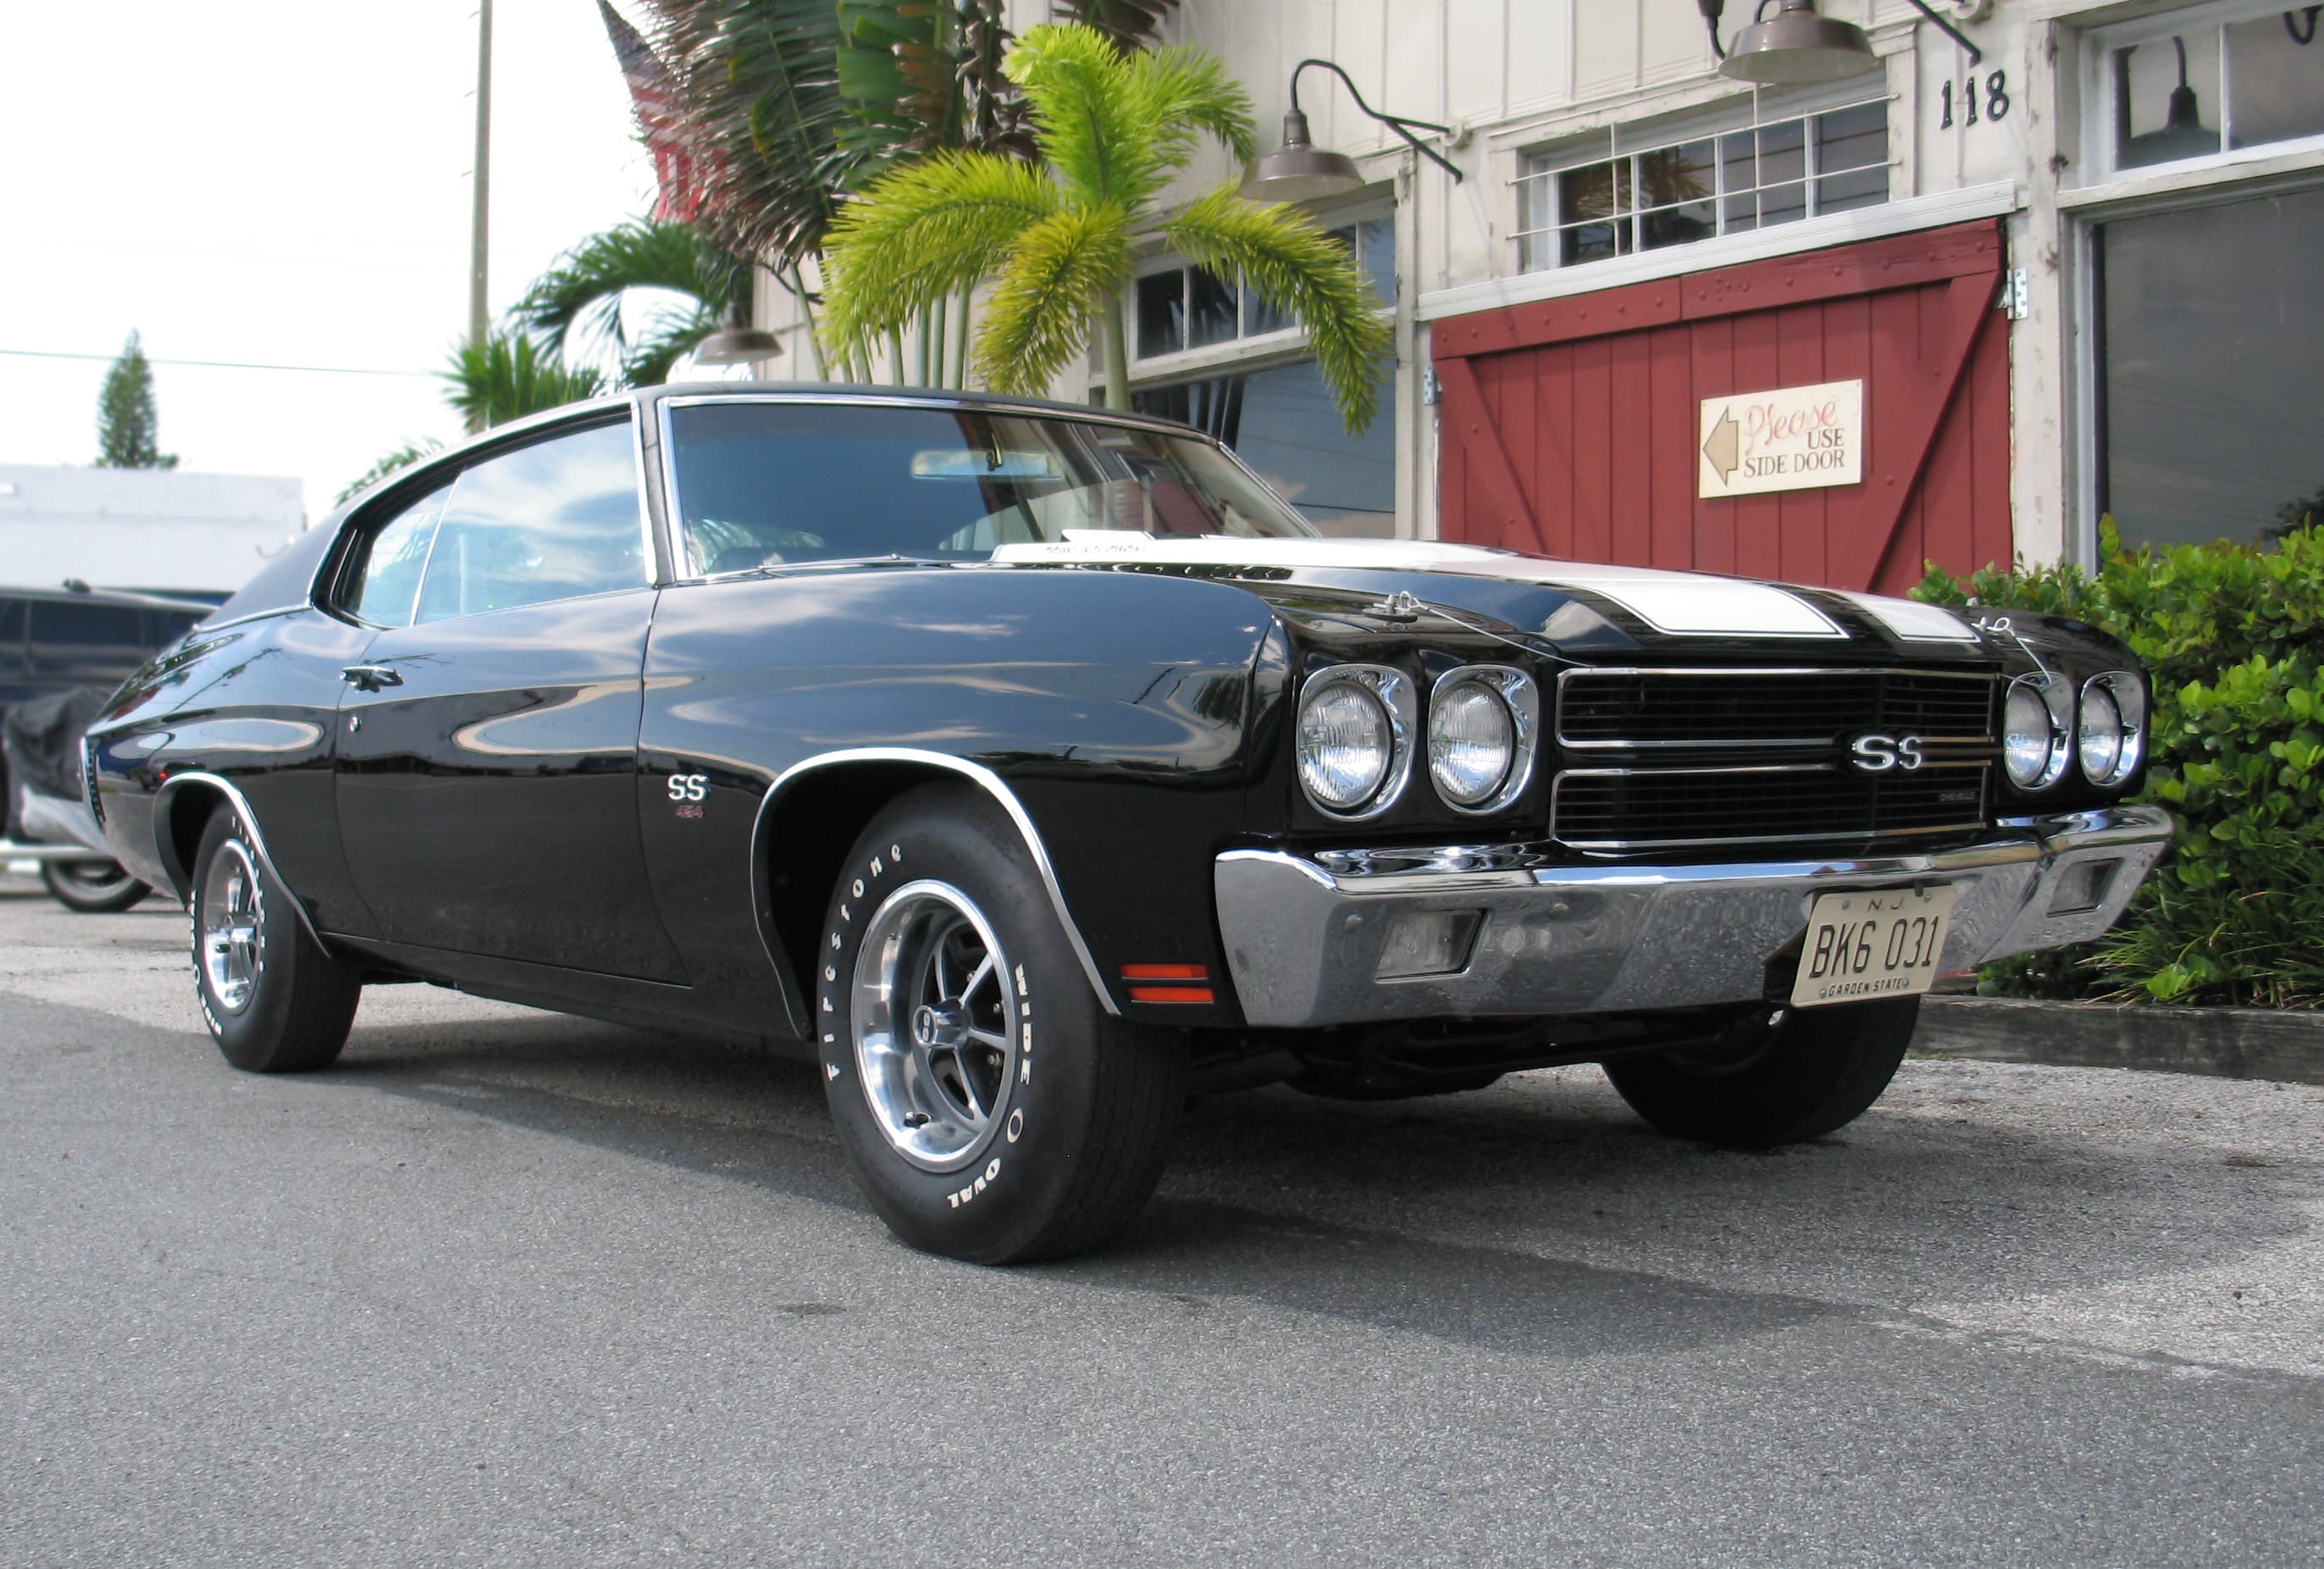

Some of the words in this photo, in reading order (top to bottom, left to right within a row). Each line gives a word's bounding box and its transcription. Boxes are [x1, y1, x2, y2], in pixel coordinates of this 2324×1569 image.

[1940, 69, 2010, 130] 118
[1744, 400, 1837, 457] Please
[1807, 428, 1845, 450] USE
[1743, 454, 1788, 479] SIDE
[1794, 448, 1845, 472] DOOR
[1851, 735, 1923, 770] SS
[667, 773, 710, 801] SS
[1808, 920, 1877, 979] BK6
[1884, 914, 1939, 970] 031
[1828, 983, 1870, 997] GARDEN
[1874, 977, 1904, 995] STATE
[1015, 963, 1033, 1085] WIDE
[947, 1157, 1002, 1209] OVAL
